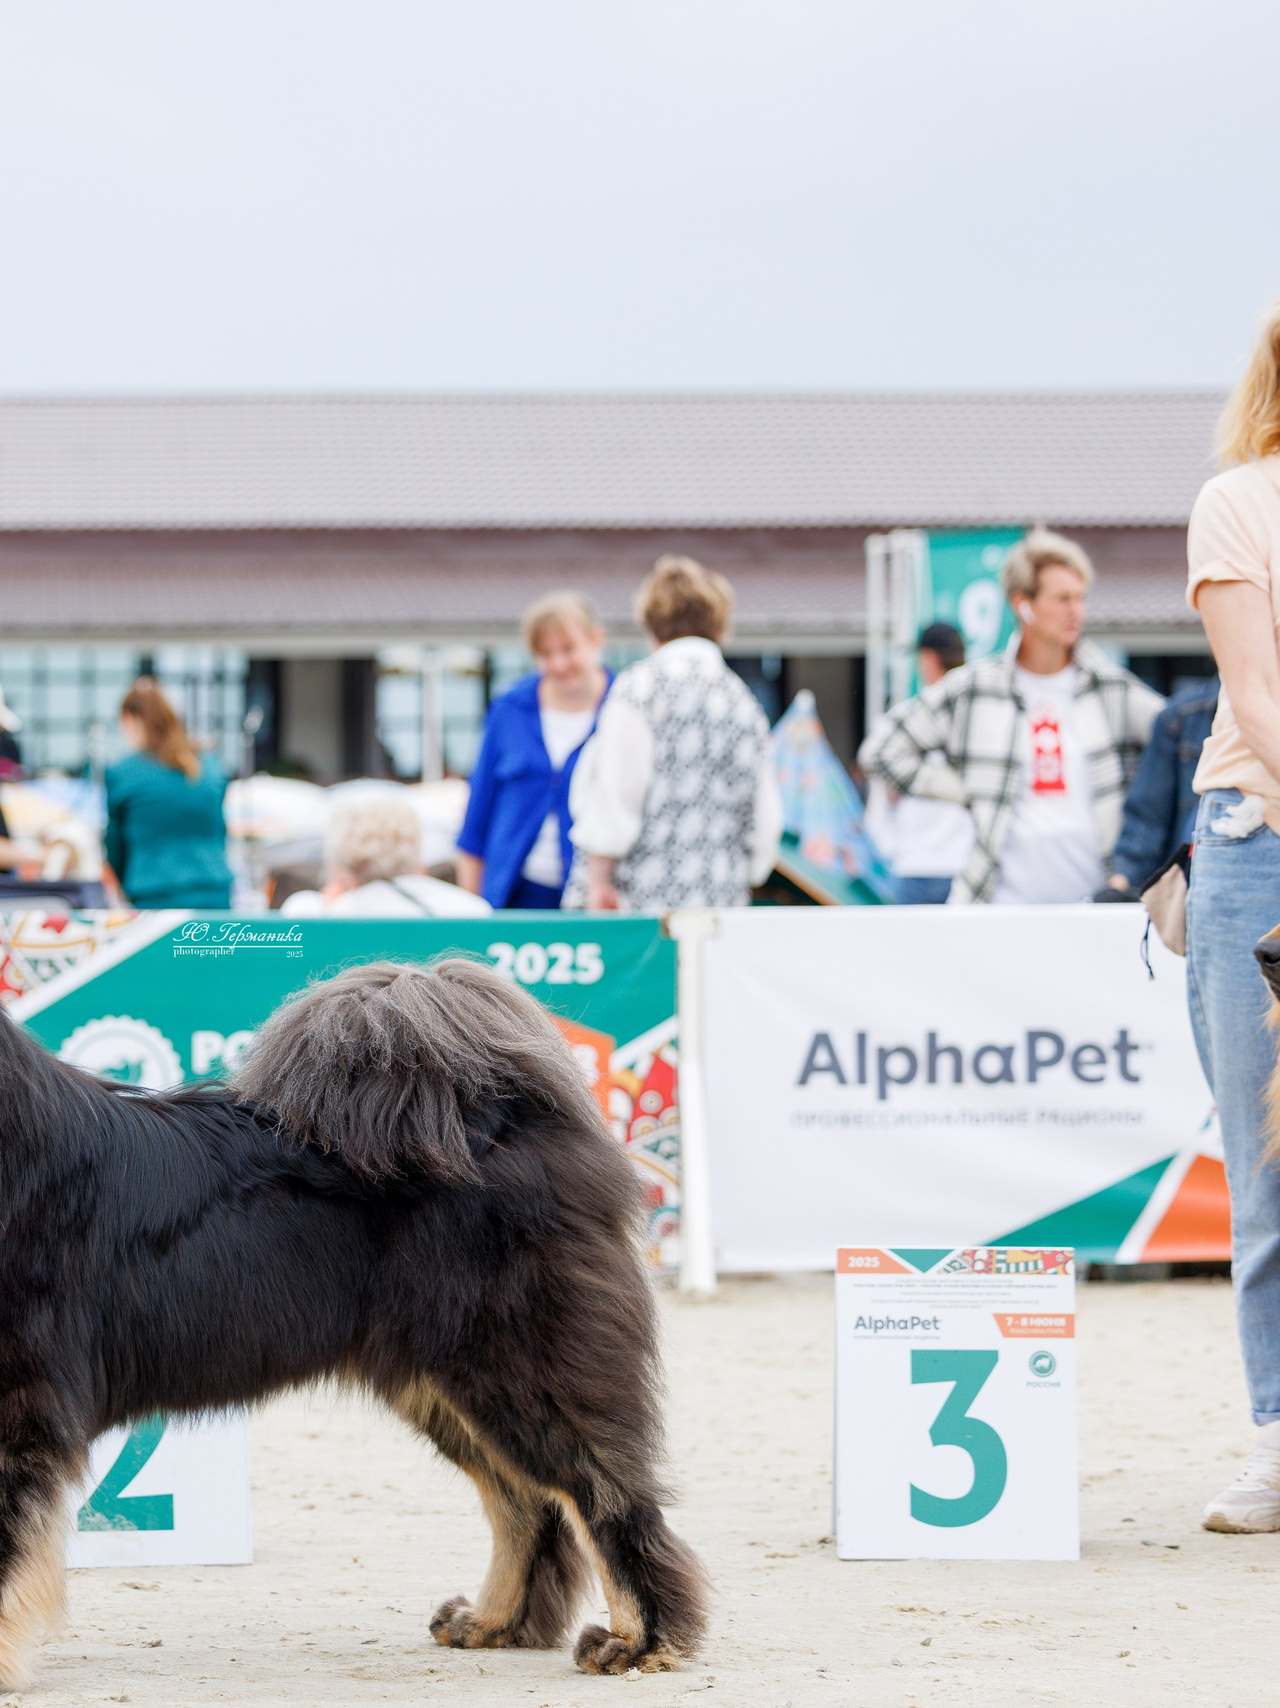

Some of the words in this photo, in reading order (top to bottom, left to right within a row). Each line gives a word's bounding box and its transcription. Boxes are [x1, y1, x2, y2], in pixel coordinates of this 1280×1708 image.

[486, 942, 605, 985] 2025
[797, 1030, 1141, 1101] AlphaPet
[847, 1256, 880, 1268] 2025
[854, 1315, 940, 1333] AlphaPet
[1005, 1316, 1013, 1326] 7
[1020, 1316, 1028, 1326] 8
[909, 1349, 1008, 1528] 3
